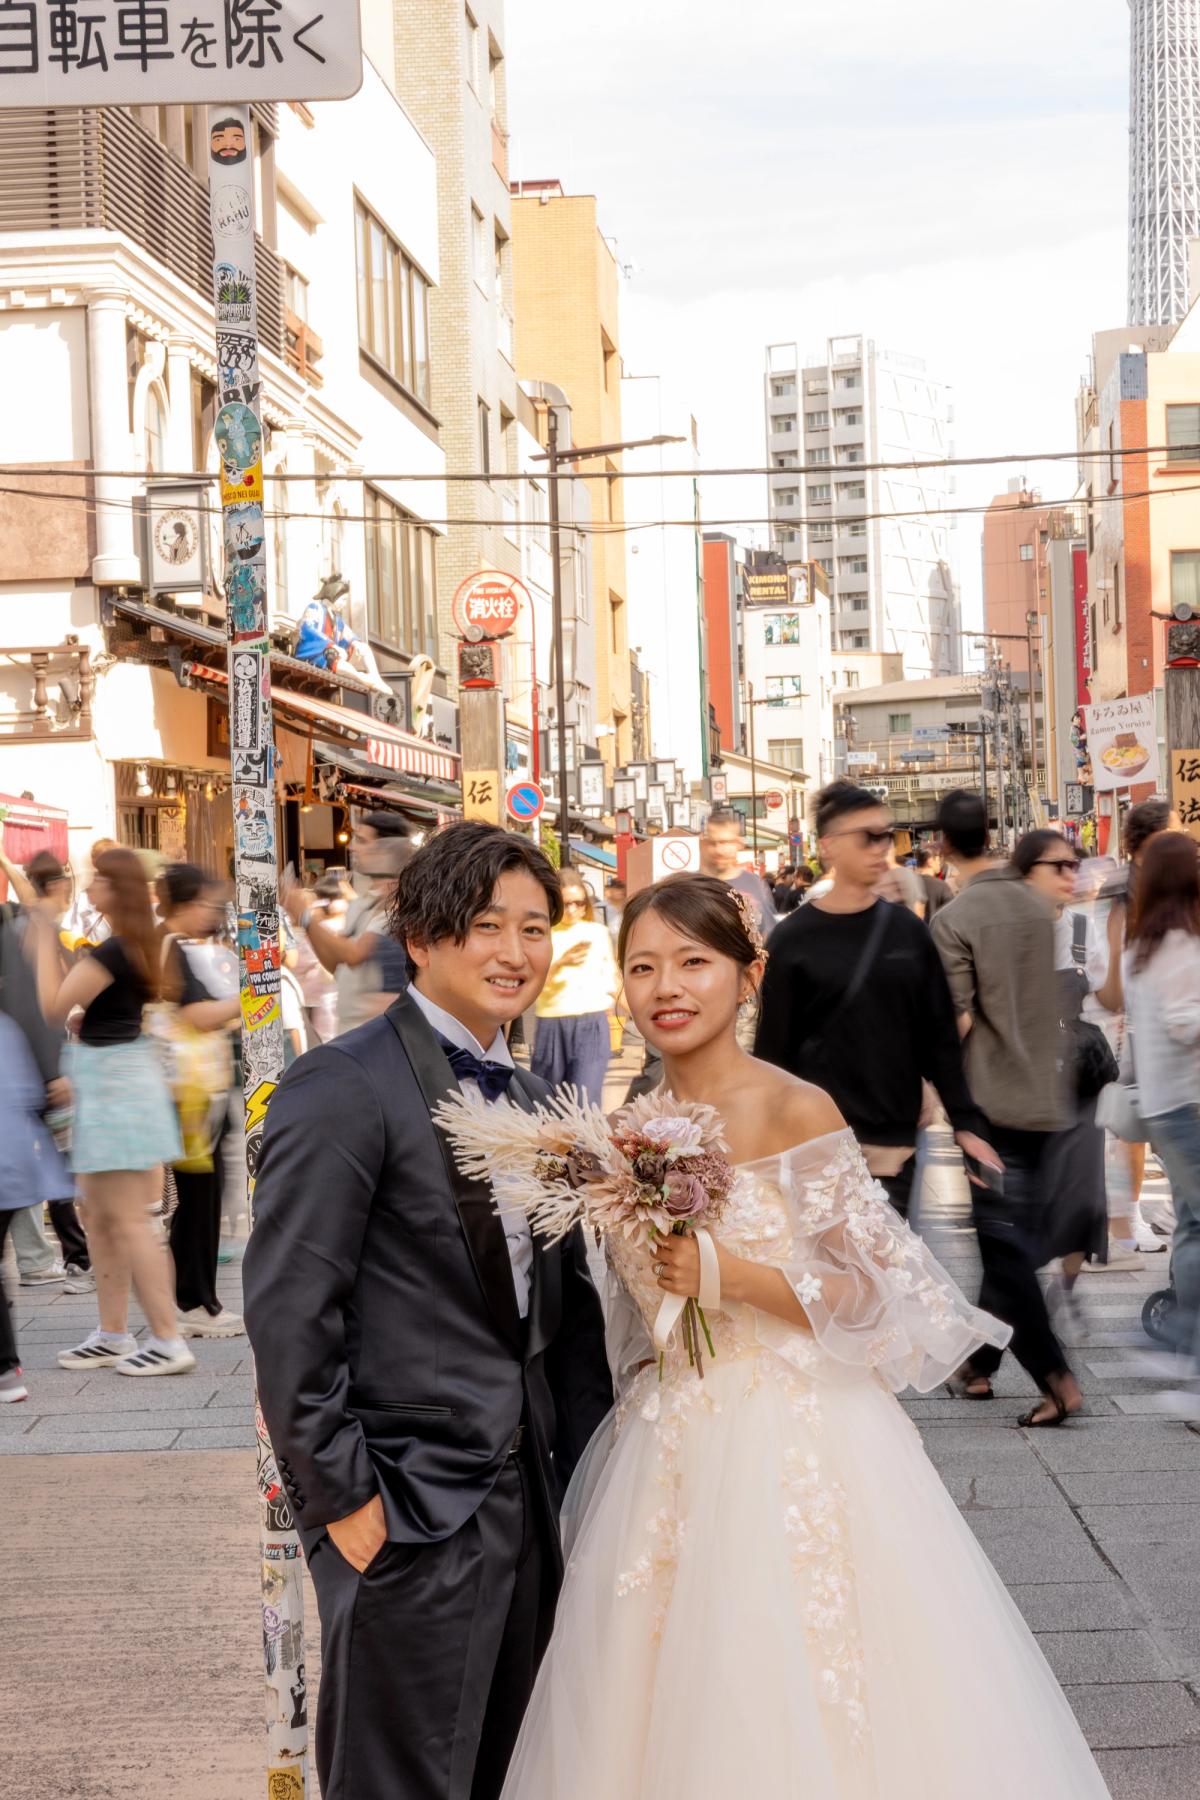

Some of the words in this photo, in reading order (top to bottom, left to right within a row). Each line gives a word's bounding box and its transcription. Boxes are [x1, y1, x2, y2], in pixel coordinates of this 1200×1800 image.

[0, 0, 327, 73] 自転車を除く
[748, 574, 787, 584] KIMONO
[749, 586, 787, 596] RENTAL
[468, 597, 515, 619] 消火栓
[467, 780, 493, 805] 伝
[250, 973, 261, 984] YOU
[255, 984, 267, 995] THE
